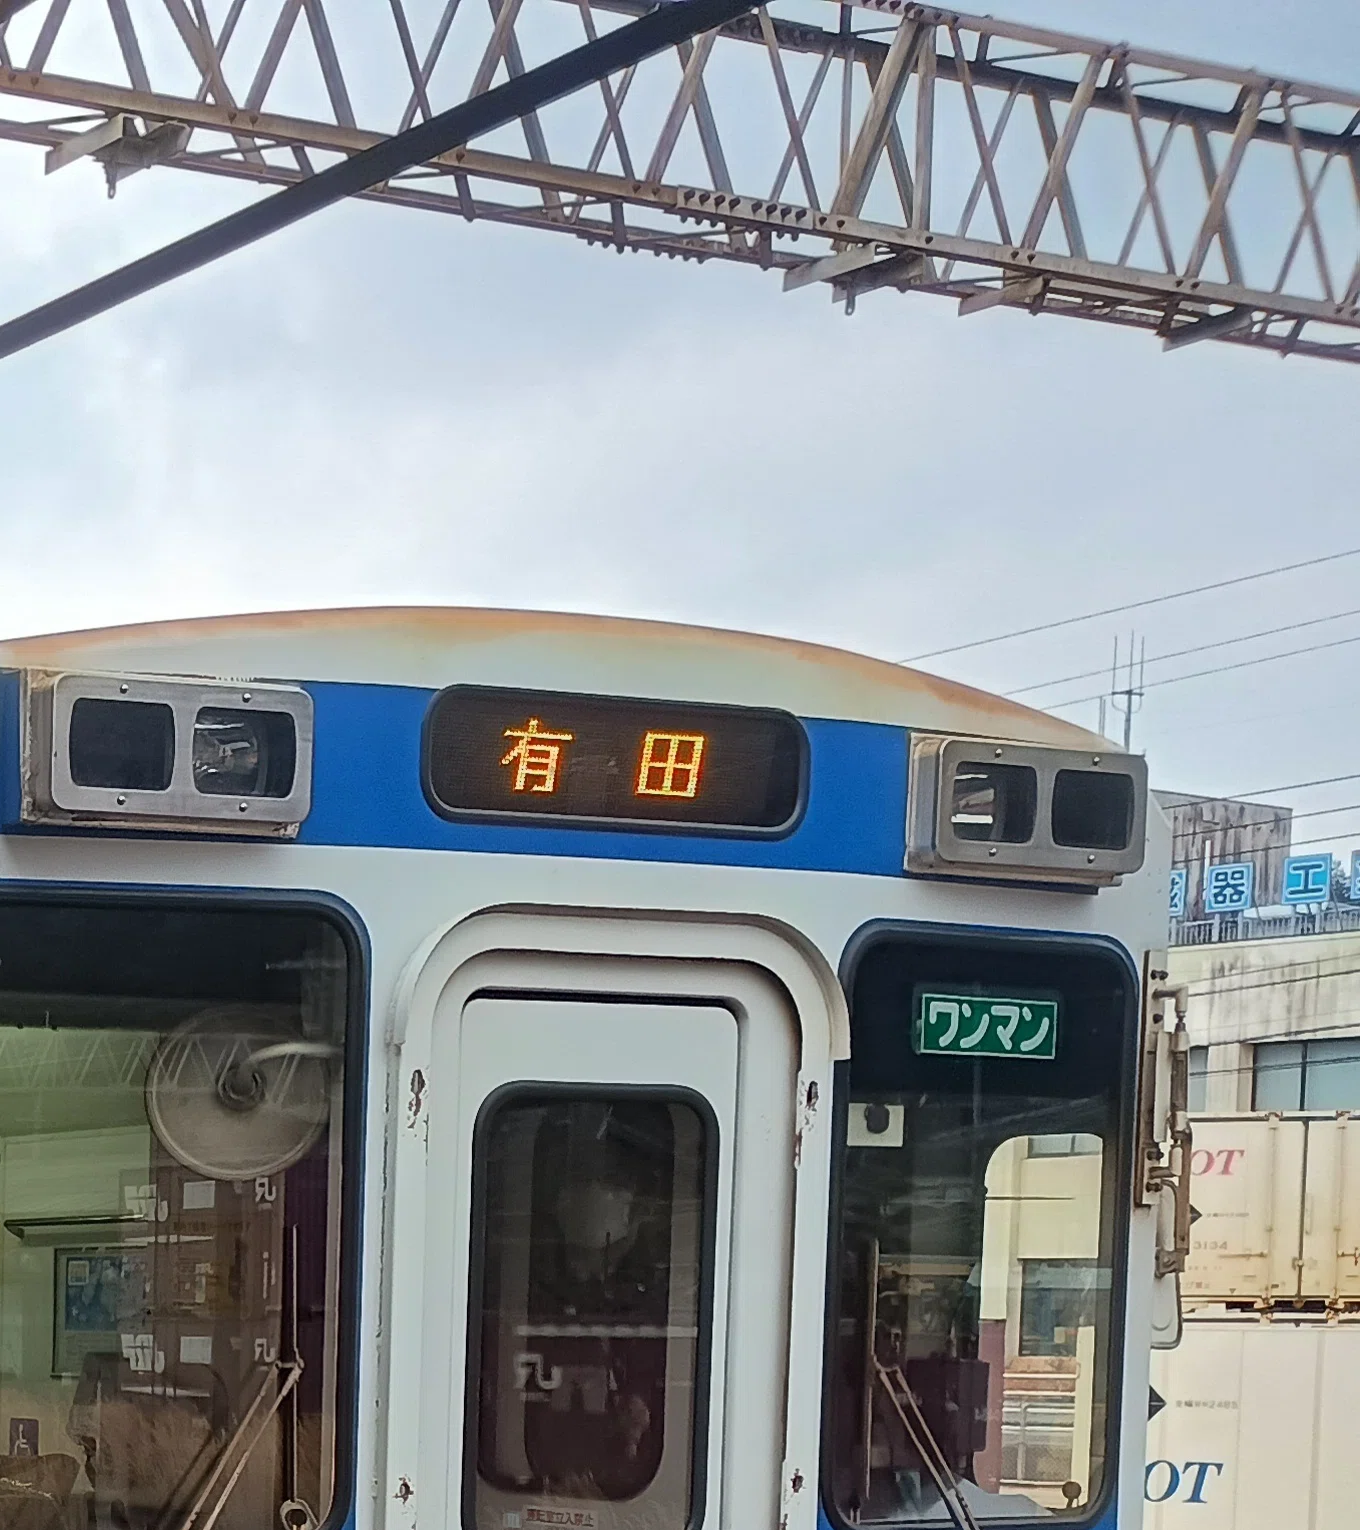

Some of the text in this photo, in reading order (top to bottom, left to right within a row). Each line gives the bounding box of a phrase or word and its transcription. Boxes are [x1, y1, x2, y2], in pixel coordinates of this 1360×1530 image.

[500, 716, 706, 798] 有田
[929, 1001, 1050, 1052] ワンマン
[1190, 1149, 1245, 1176] OT
[1143, 1459, 1224, 1504] OT
